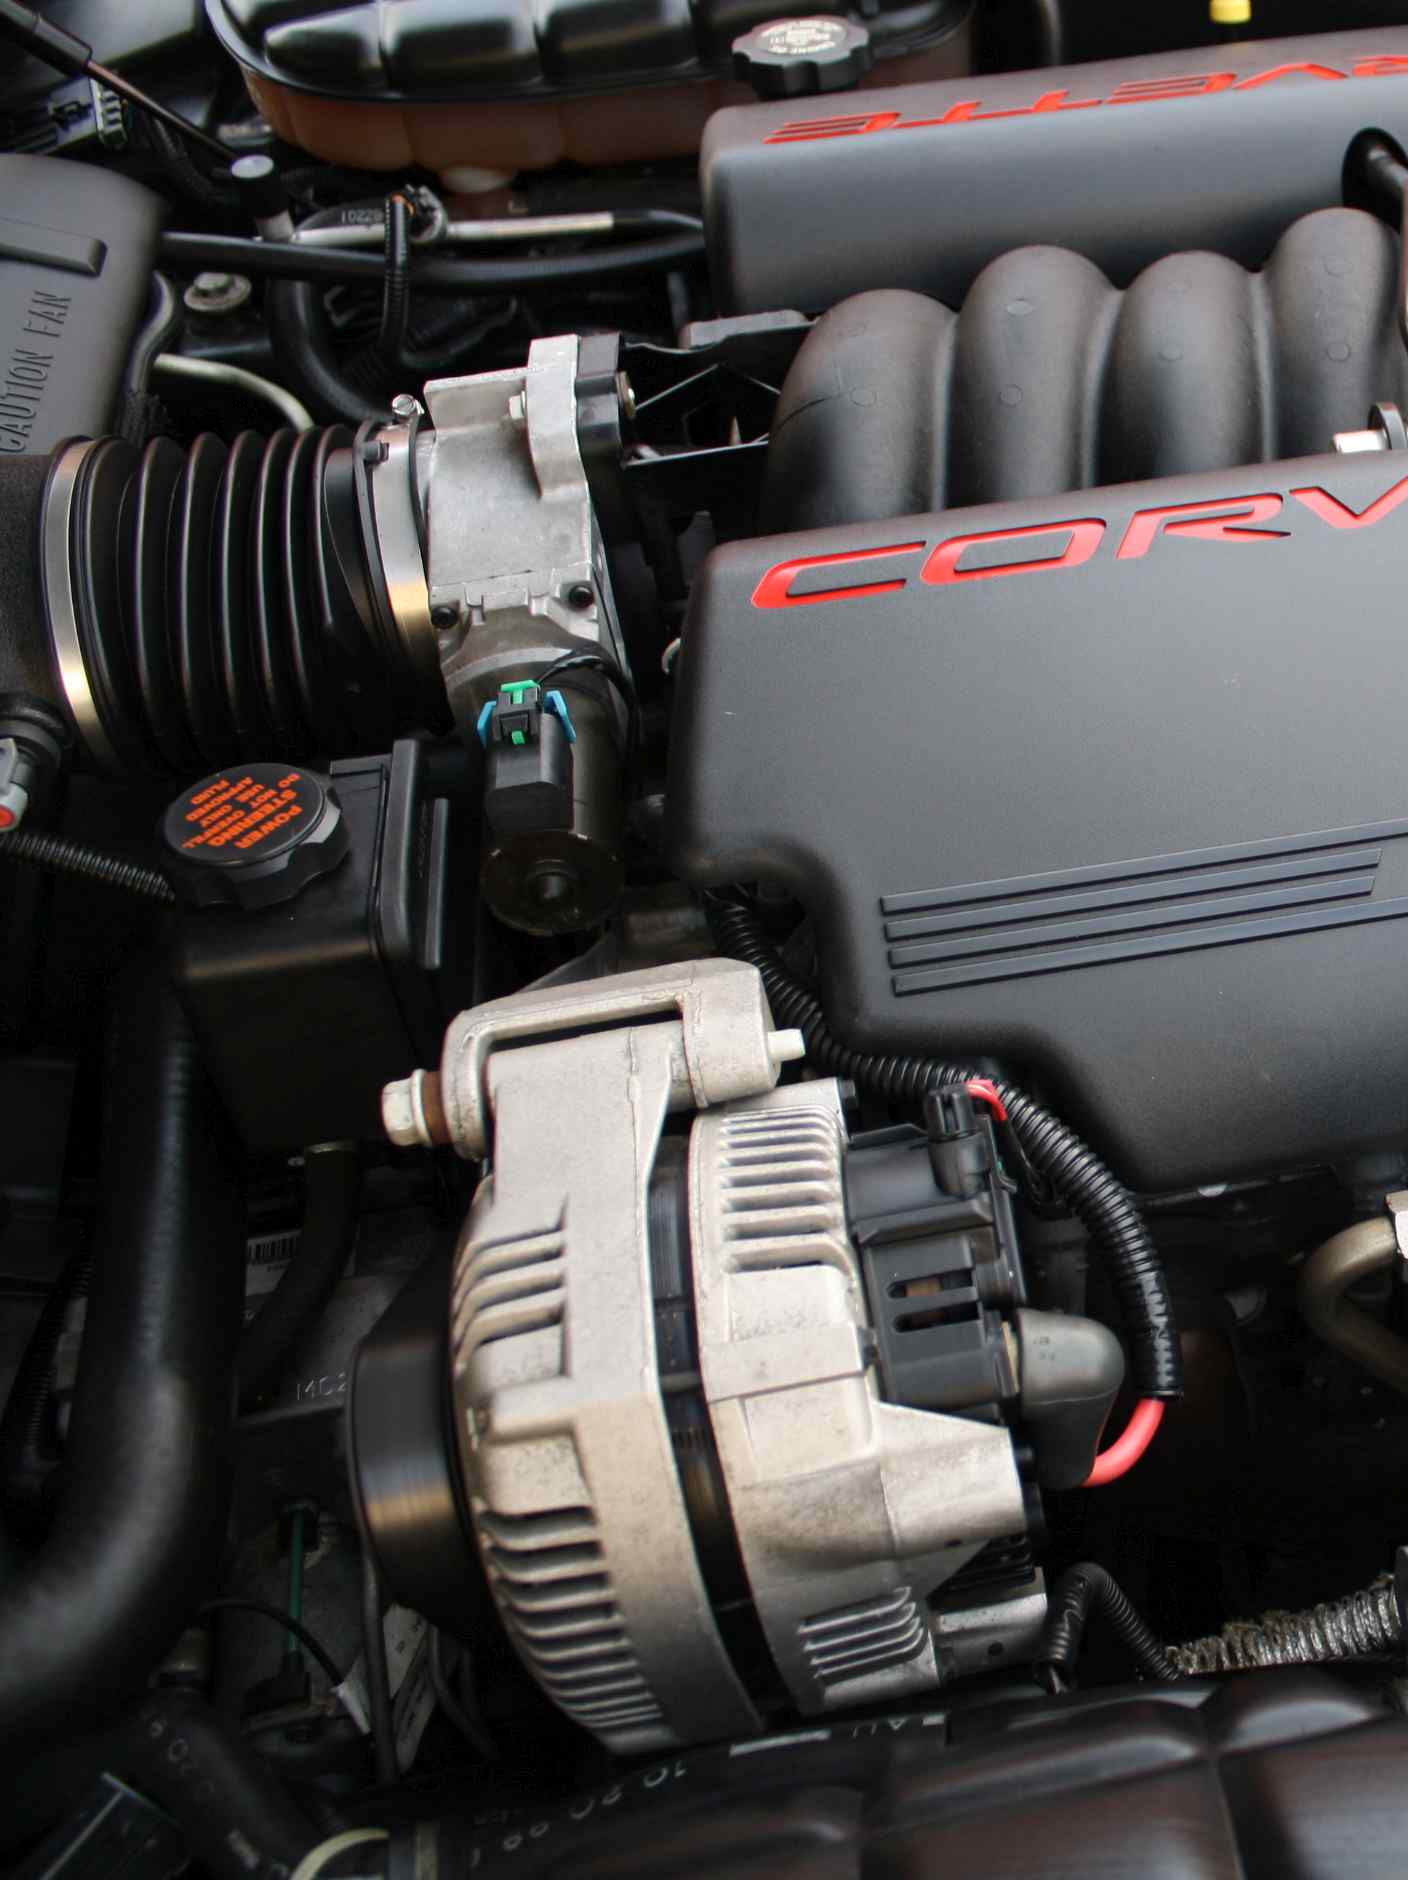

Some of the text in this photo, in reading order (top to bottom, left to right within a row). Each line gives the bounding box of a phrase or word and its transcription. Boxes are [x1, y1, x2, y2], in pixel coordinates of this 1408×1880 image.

[22, 290, 72, 338] FAN
[181, 772, 301, 849] DO NOT OVERFILL
[185, 776, 253, 822] APPROVED
[190, 779, 230, 805] FLUID
[200, 783, 265, 828] USE ONLY
[206, 788, 298, 848] STEERING
[234, 804, 303, 849] POWER
